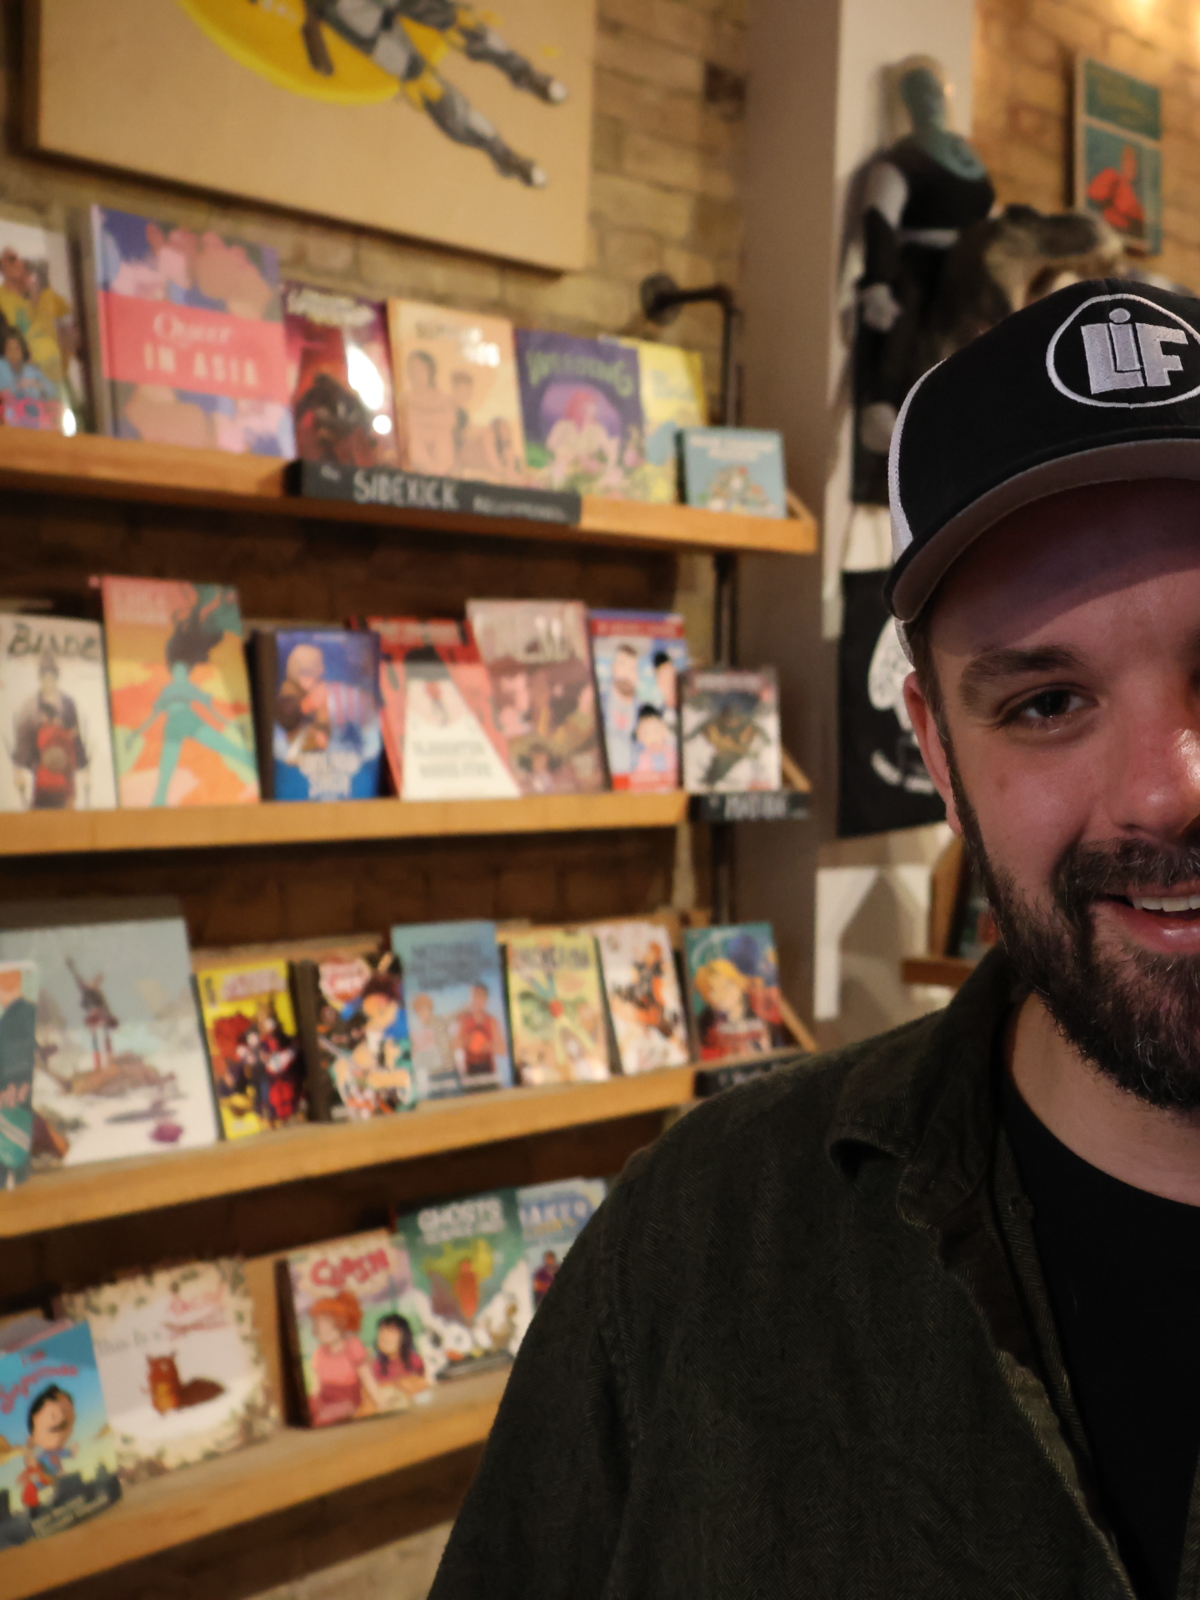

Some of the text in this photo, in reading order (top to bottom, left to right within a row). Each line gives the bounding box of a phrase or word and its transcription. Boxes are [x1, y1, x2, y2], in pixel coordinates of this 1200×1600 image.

[143, 340, 260, 388] IN ASIA
[353, 467, 459, 513] SIDEKICK
